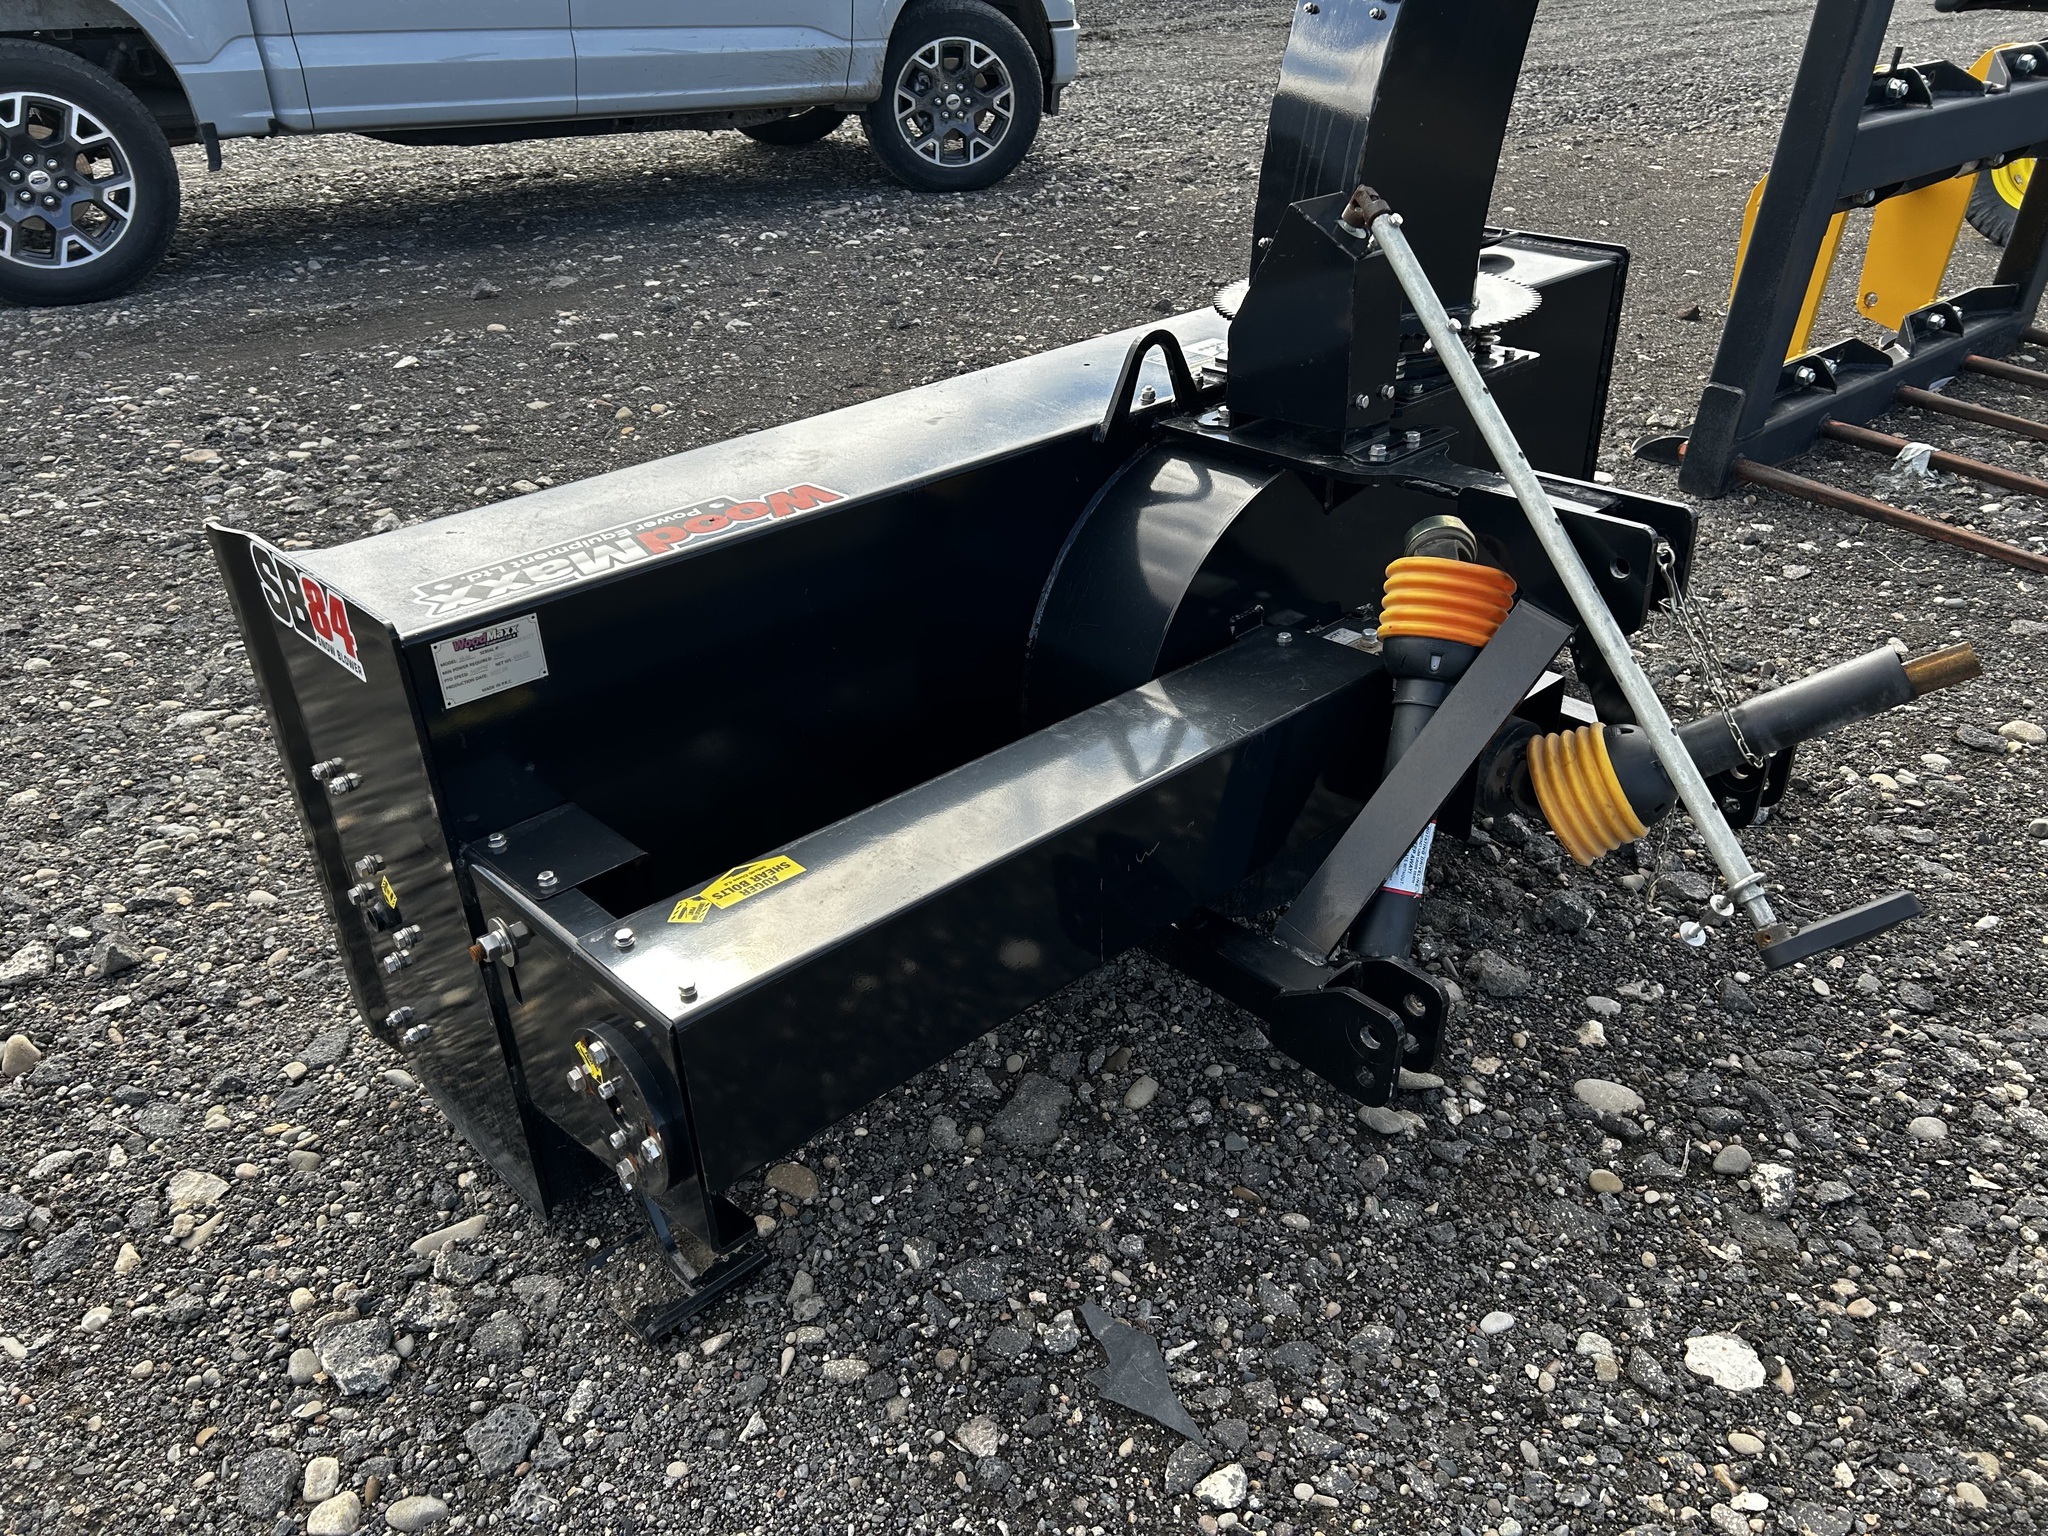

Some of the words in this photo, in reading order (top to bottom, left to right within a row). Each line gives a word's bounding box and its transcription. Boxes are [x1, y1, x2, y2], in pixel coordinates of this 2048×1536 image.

[636, 508, 702, 532] Power
[427, 484, 844, 613] WoodMaxx
[510, 528, 632, 567] Equipment
[461, 565, 506, 582] Ltd.
[252, 543, 357, 660] SB84
[452, 624, 519, 652] WoodMaxx
[317, 635, 336, 657] SNOW
[337, 649, 363, 675] BLOWER
[453, 664, 469, 672] POWER
[446, 678, 475, 690] PRODUCTION
[481, 684, 495, 692] MADE
[750, 862, 791, 882] SHEAR
[1415, 855, 1424, 887] DRIVELINE
[712, 881, 751, 900] BOLTS
[740, 875, 778, 896] AUGER
